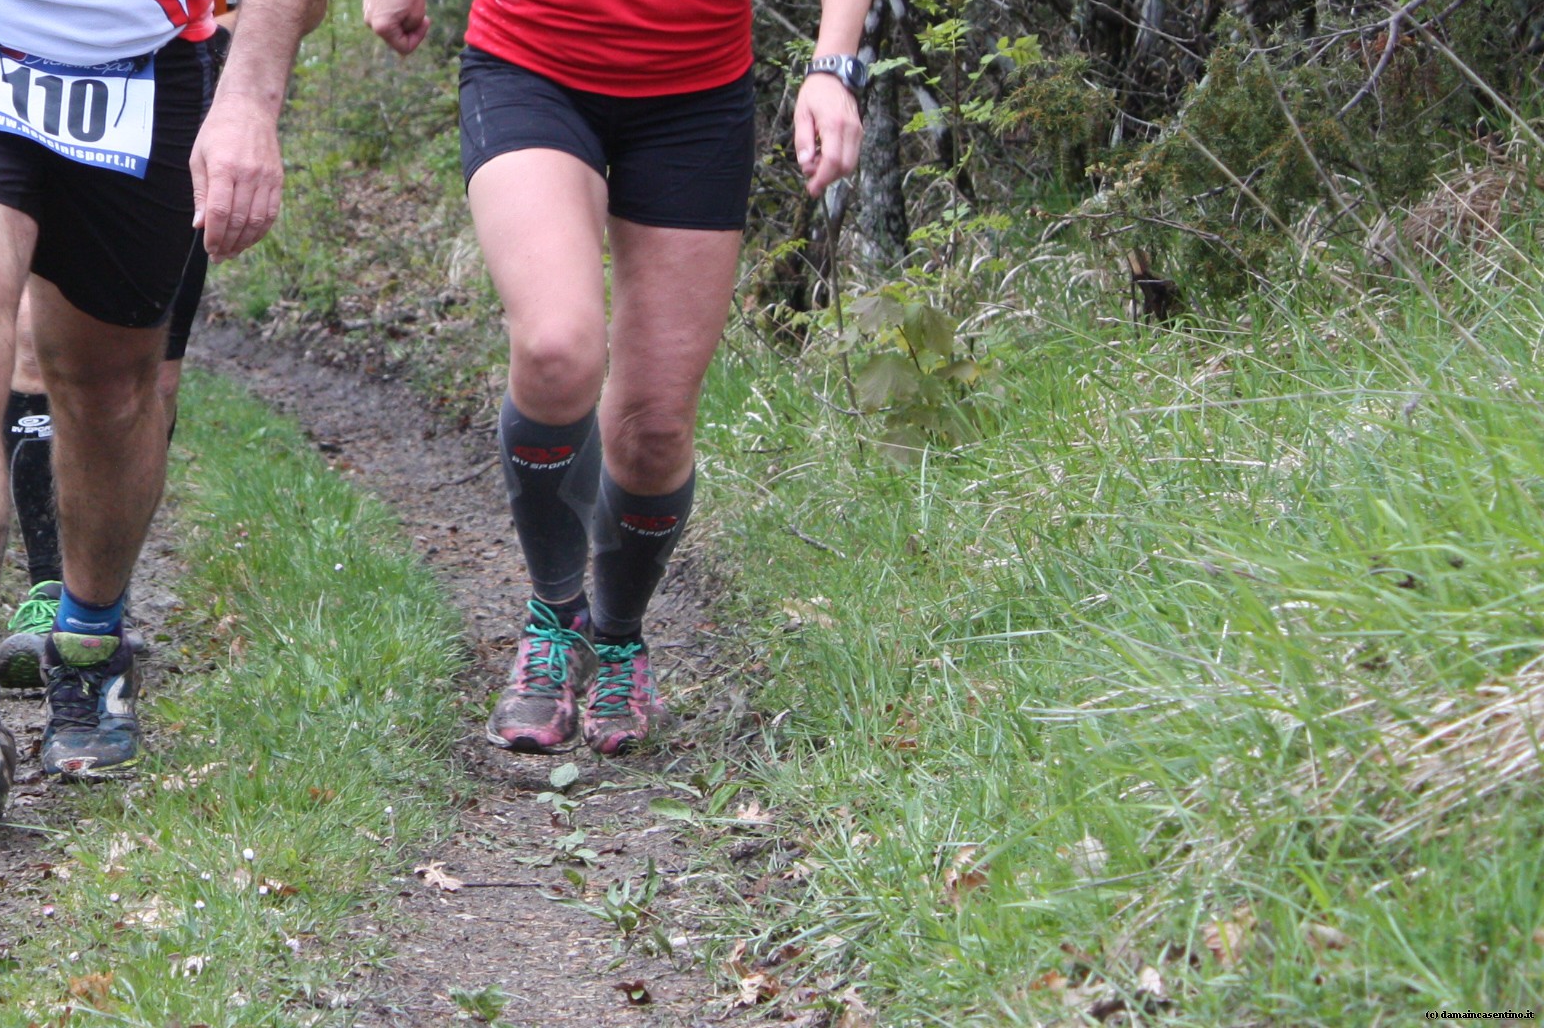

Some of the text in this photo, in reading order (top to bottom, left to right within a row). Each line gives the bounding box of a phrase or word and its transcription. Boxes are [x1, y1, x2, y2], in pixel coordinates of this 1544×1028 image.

[2, 66, 109, 142] 110
[529, 456, 574, 470] SPORT
[636, 522, 678, 537] SPORT
